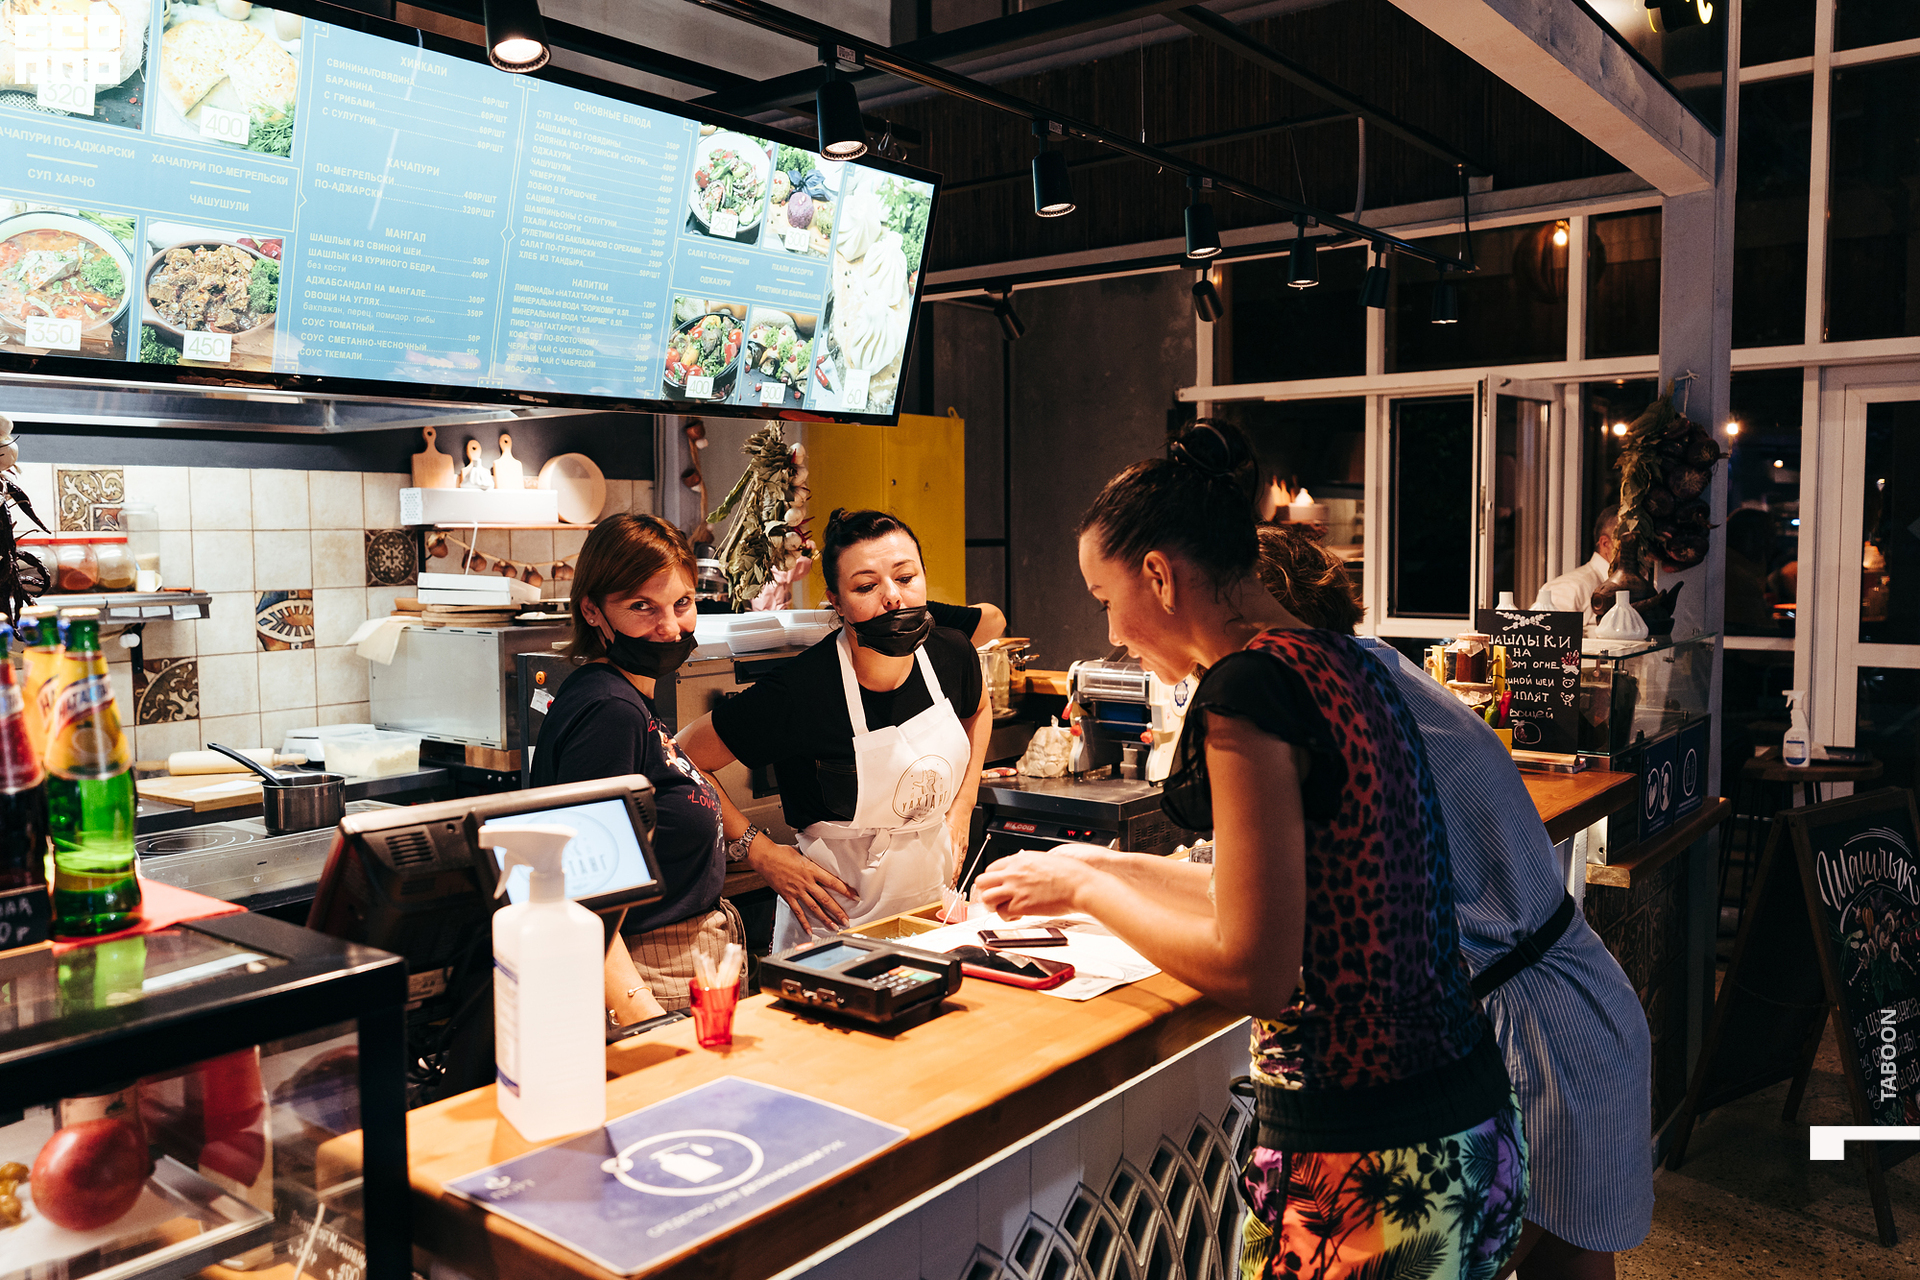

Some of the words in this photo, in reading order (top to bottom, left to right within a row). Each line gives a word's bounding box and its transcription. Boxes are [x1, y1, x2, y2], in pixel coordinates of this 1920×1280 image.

[400, 56, 448, 77] ХИНКАЛИ
[325, 74, 373, 93] БАРАНИНА
[324, 91, 330, 99] С
[334, 92, 375, 109] ГРИБАМИ
[322, 107, 328, 115] С
[332, 108, 376, 126] СУЛУГУНИ
[537, 109, 551, 120] СУП
[554, 114, 578, 126] ХАРЧО
[574, 101, 620, 121] ОСНОВНЫЕ
[623, 114, 651, 129] БЛЮДА
[205, 114, 244, 138] 400
[536, 122, 571, 136] ХАШЛАМА
[573, 130, 582, 139] ИЗ
[584, 132, 622, 148] ГОВЯДИНЫ
[54, 136, 136, 159] ПО-АДЖАРСКИ
[533, 145, 572, 161] ОДЖАХУРИ
[534, 133, 567, 148] СОЛЯНКА
[570, 141, 619, 159] ПО-ГРУЗИНСКИ
[152, 153, 207, 172] ХАЧАПУРИ
[208, 162, 288, 186] ПО-МЕГРЕЛЬСКИ
[386, 157, 440, 176] ХАЧАПУРИ
[531, 157, 571, 172] ЧАШУШУЛИ
[28, 168, 52, 180] СУП
[55, 172, 96, 188] ХАРЧО
[316, 162, 394, 185] ПО-МЕГРЕЛЬСКИ
[530, 169, 566, 183] ЧКМЕРУЛИ
[314, 179, 382, 198] ПО-АДЖАРСКИ
[527, 182, 552, 193] ЛОБИО
[560, 188, 597, 201] ГОРШОЧКЕ
[190, 194, 250, 212] ЧАШУШУЛИ
[526, 192, 555, 205] САЦИВИ
[523, 216, 547, 227] ПХАЛИ
[549, 221, 581, 232] АССОРТИ
[524, 204, 576, 221] ШАМПИНЬОНЫ
[584, 215, 617, 228] СУЛУГУНИ
[712, 215, 734, 234] 250
[385, 228, 426, 242] МАНГАЛ
[522, 227, 555, 240] РУЛЕТИКИ
[565, 234, 607, 249] БАКЛАЖАНОВ
[788, 231, 806, 247] 300
[310, 232, 351, 246] ШАШЛЫК
[354, 239, 364, 248] ИЗ
[367, 241, 401, 254] СВИНОЙ
[403, 246, 421, 256] ШЕИ
[520, 239, 544, 250] САЛАТ
[545, 243, 596, 257] ПО-ГРУЗИНСКИ
[308, 248, 350, 261] ШАШЛЫК
[352, 254, 363, 263] ИЗ
[365, 256, 407, 269] КУРИНОГО
[410, 262, 436, 273] БЕДРА
[518, 251, 537, 260] ХЛЕБ
[540, 254, 549, 262] ИЗ
[551, 255, 584, 268] ТАНДЫРА
[688, 248, 707, 259] САЛАТ
[324, 264, 346, 273] кости
[306, 275, 372, 291] АДЖАБСАНДАЛ
[374, 284, 386, 292] НА
[389, 285, 426, 297] МАНГАЛЕ
[514, 284, 554, 296] ЛИМОНАДЫ
[572, 278, 609, 291] НАПИТКИ
[304, 290, 337, 302] ОВОЩИ
[340, 294, 351, 302] НА
[354, 295, 380, 306] УГЛЯХ
[513, 295, 562, 308] МИНЕРАЛЬНАЯ
[562, 301, 579, 310] ВОДА
[510, 319, 530, 327] ПИВО
[512, 307, 560, 320] МИНЕРАЛЬНАЯ
[561, 313, 578, 322] ВОДА
[302, 317, 325, 327] СОУС
[328, 320, 375, 332] ТОМАТНЫЙ
[301, 333, 324, 342] СОУС
[509, 330, 528, 339] КОФЕ
[188, 336, 226, 357] 450
[300, 348, 322, 357] СОУС
[324, 350, 362, 360] ТКЕМАЛИ
[538, 344, 552, 353] ЧАЙ
[559, 347, 594, 358] ЧАБРЕЦОМ
[541, 356, 554, 364] ЧАЙ
[561, 359, 596, 368] ЧАБРЕЦОМ
[689, 380, 710, 395] 400
[764, 386, 783, 400] 300
[847, 388, 862, 404] 60
[1513, 648, 1532, 657] НА
[1532, 661, 1560, 670] ОГНЕ
[1816, 847, 1920, 911] Шашлык
